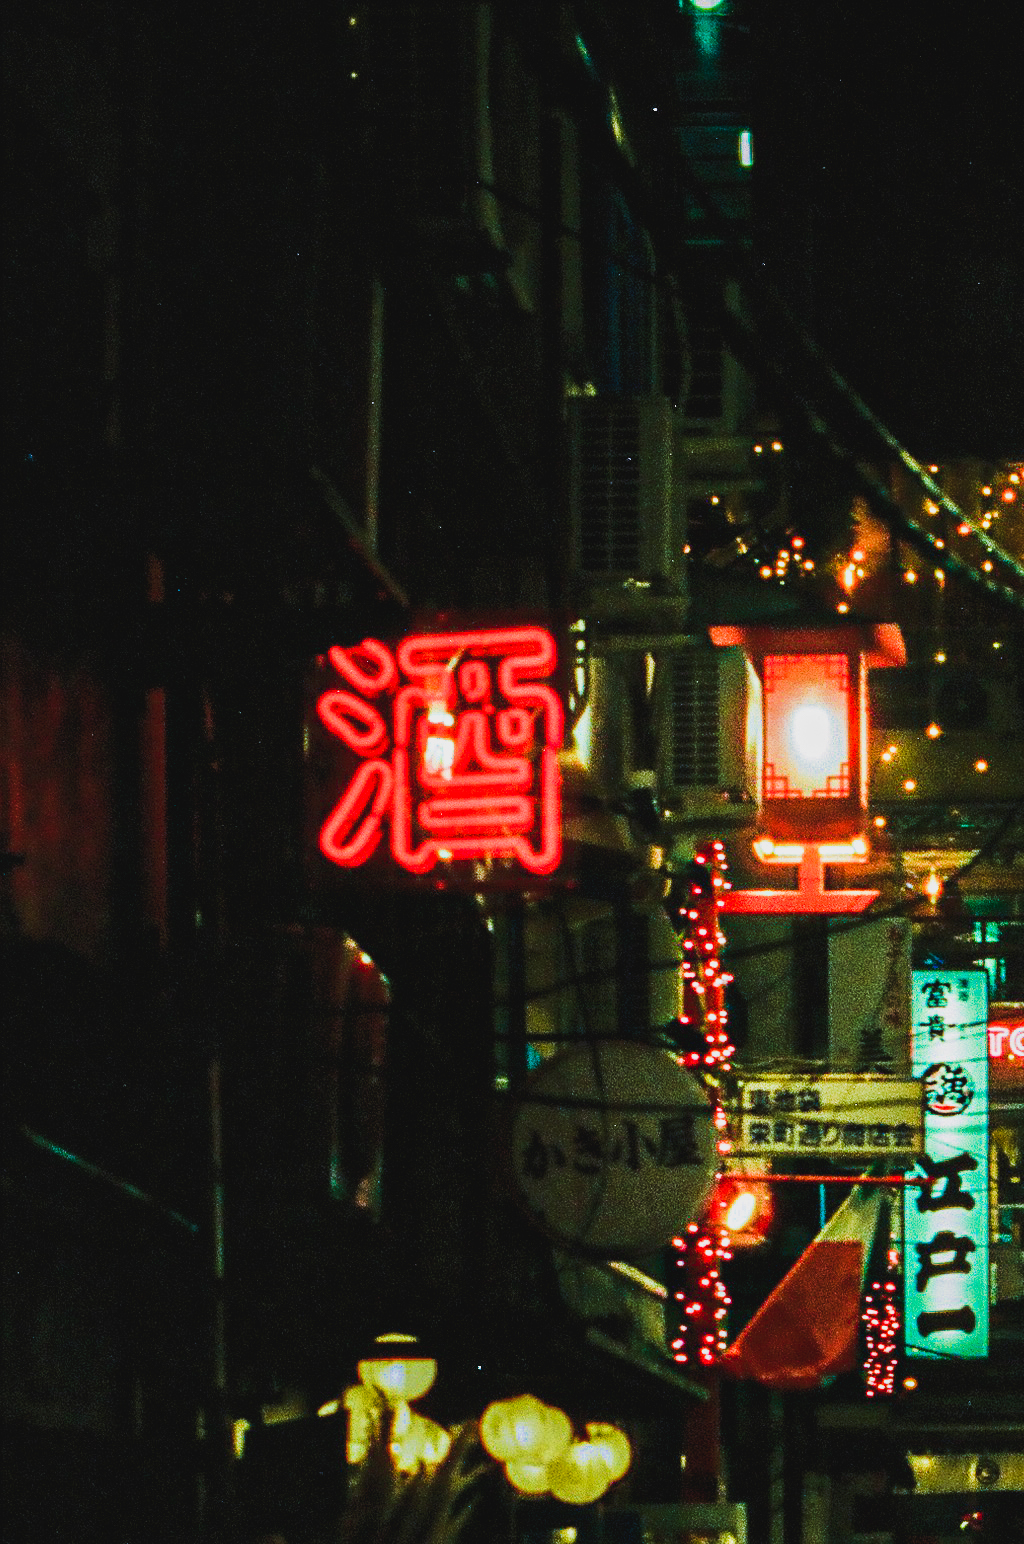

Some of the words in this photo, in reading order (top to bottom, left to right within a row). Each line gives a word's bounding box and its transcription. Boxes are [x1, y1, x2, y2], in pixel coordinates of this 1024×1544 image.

[316, 626, 565, 875] 酒
[914, 1150, 980, 1338] 江戸一
